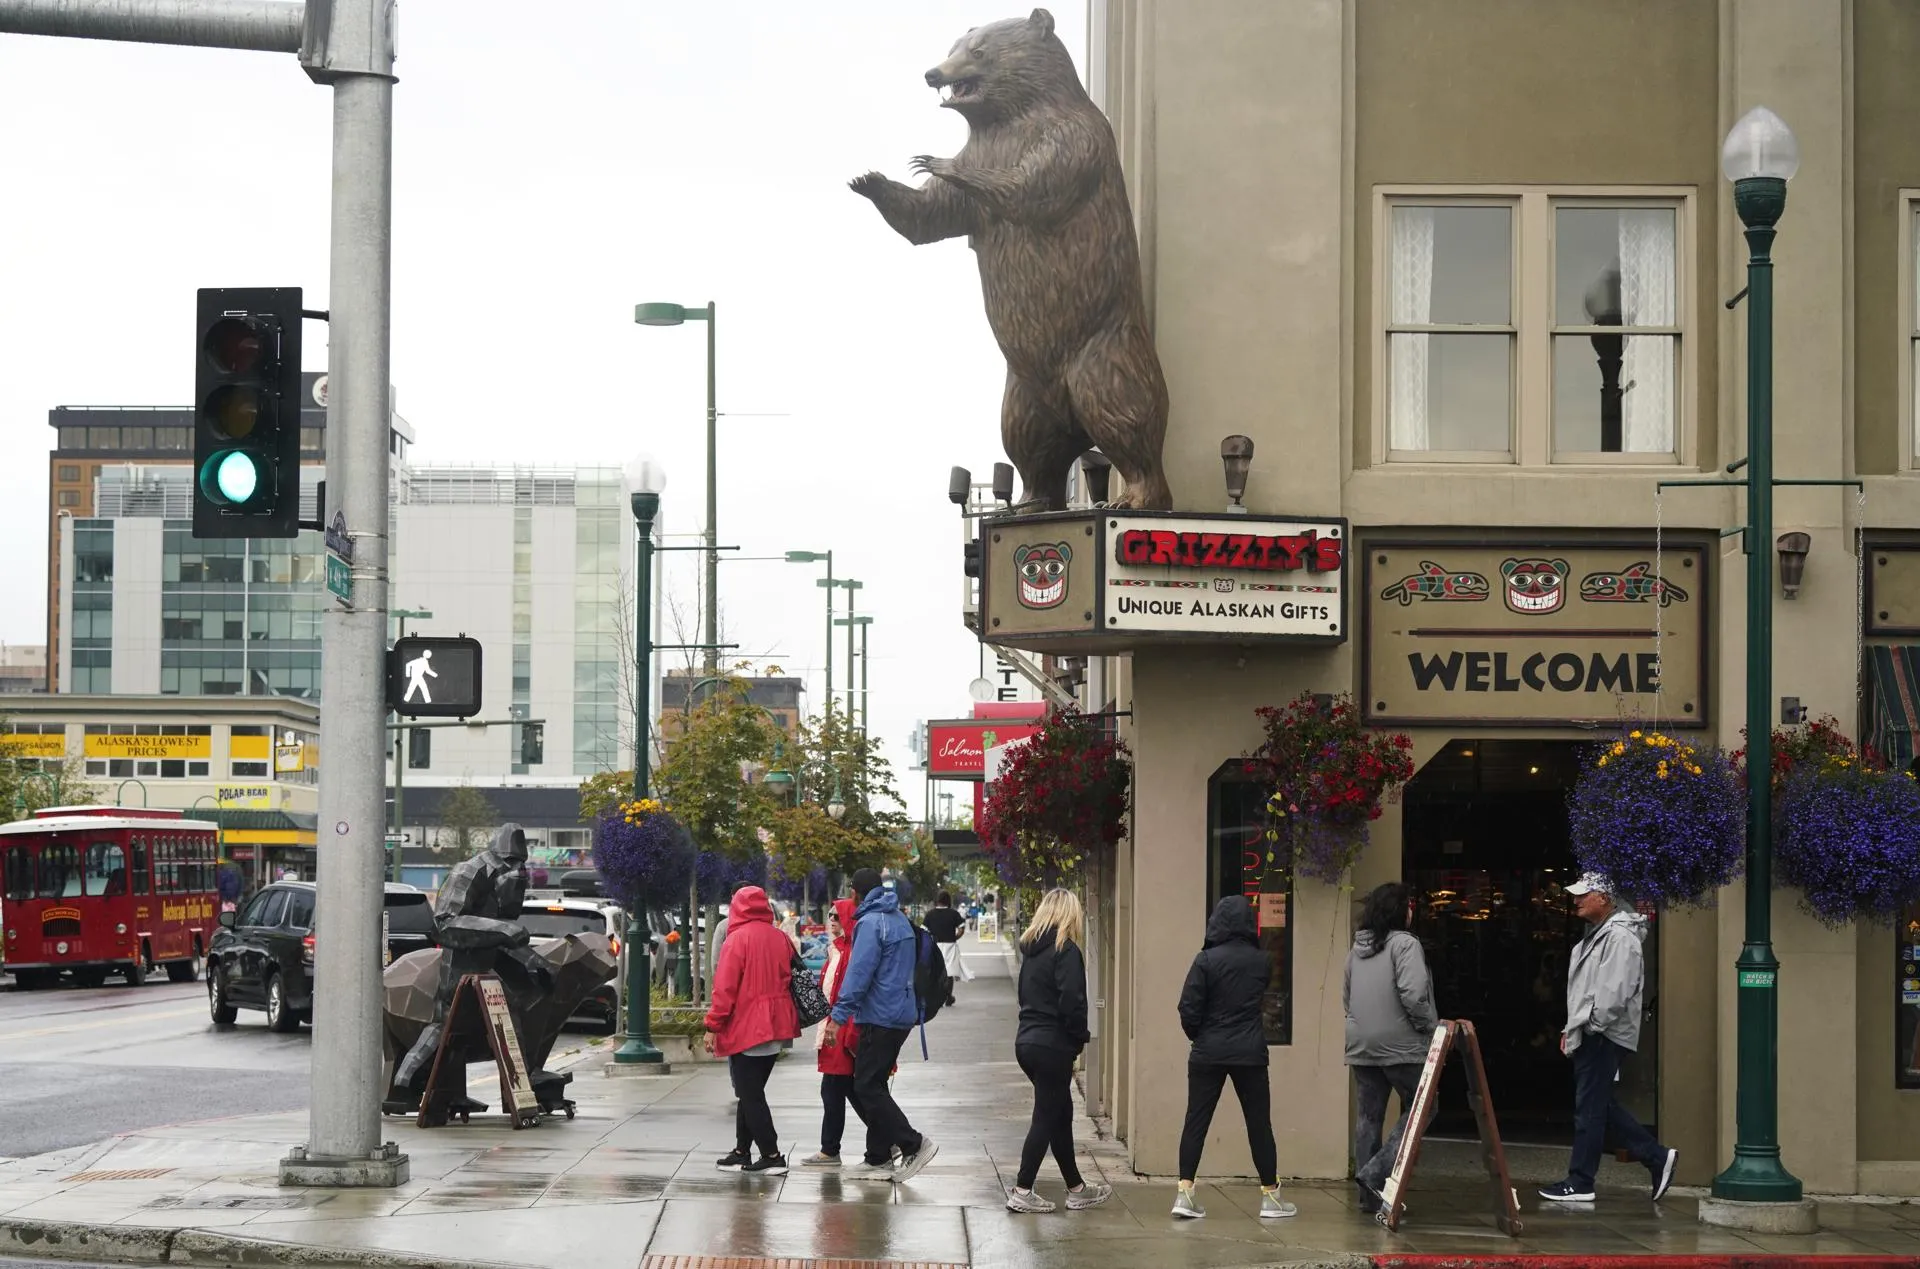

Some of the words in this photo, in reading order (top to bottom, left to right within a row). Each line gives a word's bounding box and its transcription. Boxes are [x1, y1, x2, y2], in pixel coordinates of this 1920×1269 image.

[1117, 529, 1341, 573] GRIZZLY'S
[1118, 597, 1182, 615] UNIQUE
[1190, 600, 1275, 618] ALASKAN
[1280, 603, 1329, 620] GIFTS
[1408, 651, 1662, 693] WELCOME
[96, 737, 149, 746] ALASKA'S
[152, 737, 200, 746] LOWEST
[127, 747, 168, 757] PRICES
[219, 788, 245, 800] POLAR
[247, 787, 268, 797] BEAR
